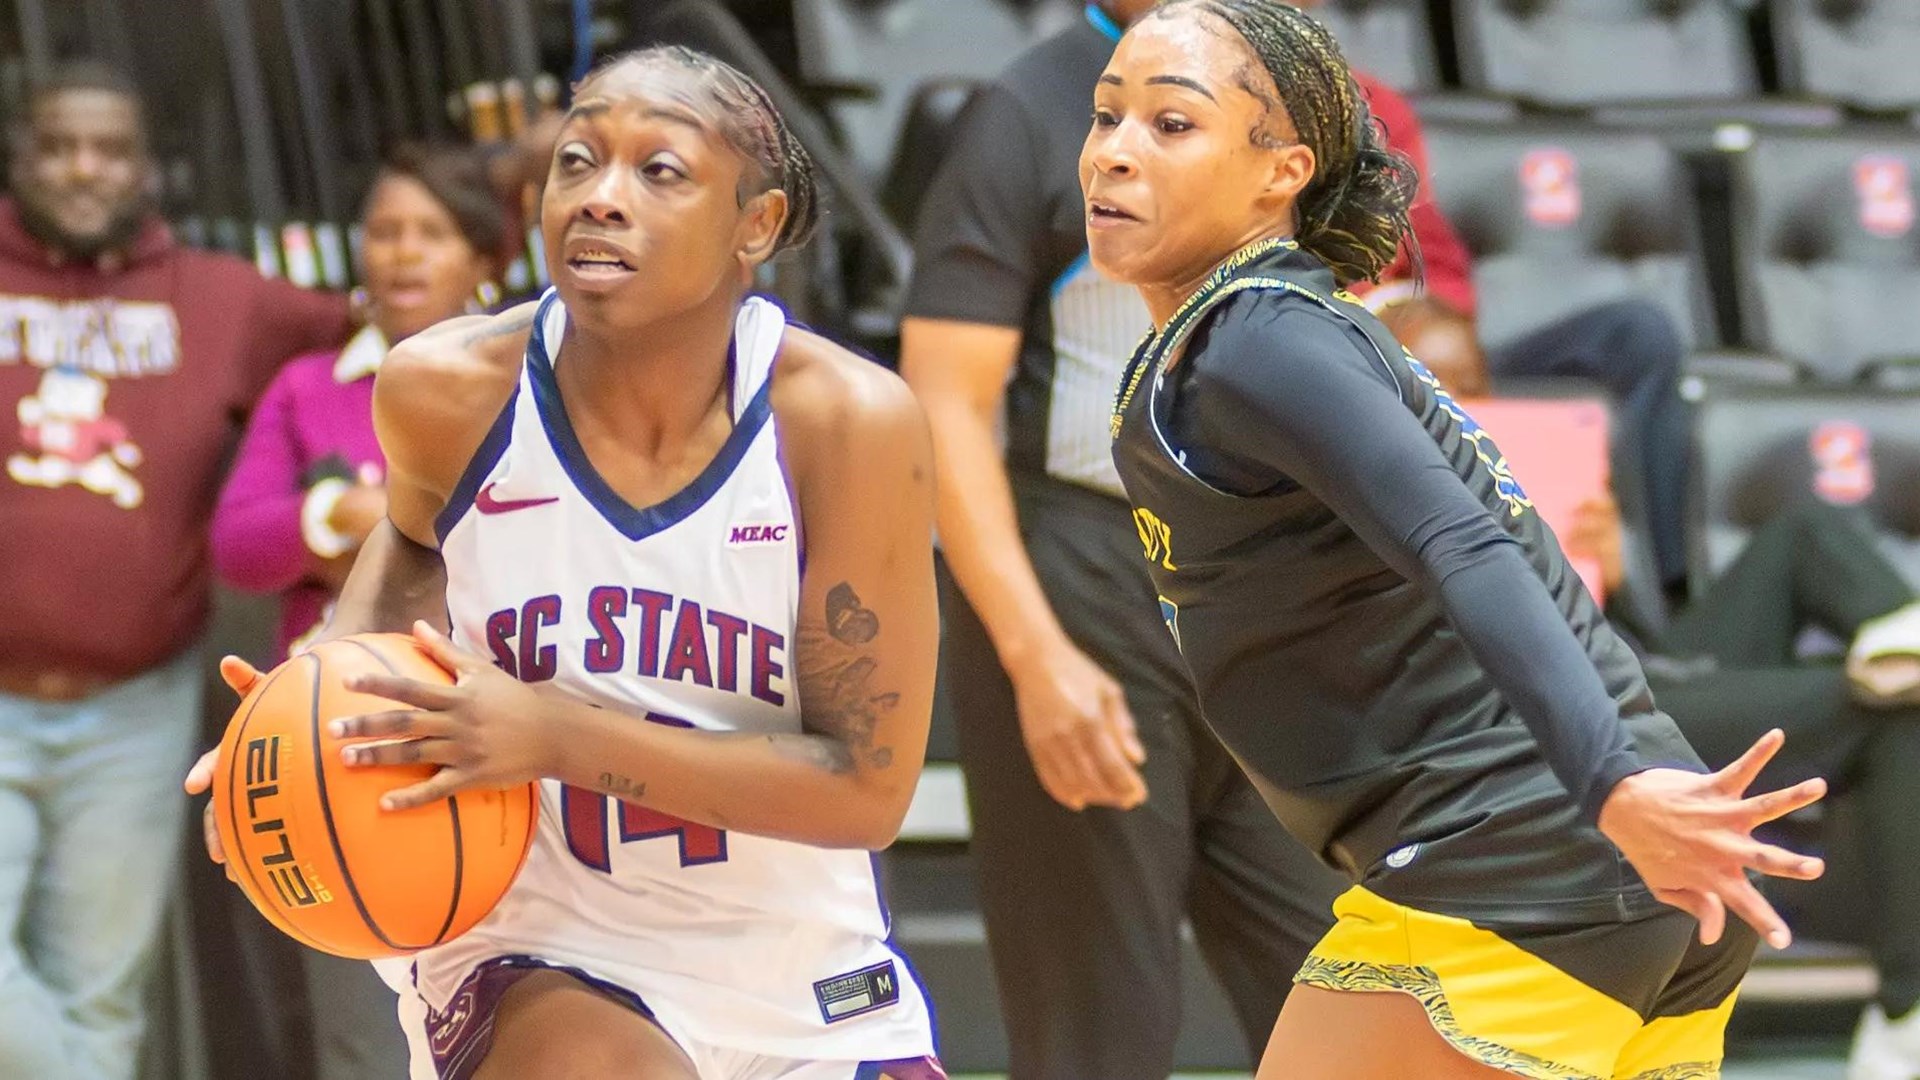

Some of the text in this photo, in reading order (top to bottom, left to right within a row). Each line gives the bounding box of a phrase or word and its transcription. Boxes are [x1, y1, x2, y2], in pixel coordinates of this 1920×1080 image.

[729, 524, 788, 543] MEAC
[486, 586, 785, 707] SC STATE
[246, 736, 318, 908] ELITE
[561, 710, 728, 874] 14
[877, 974, 892, 995] M
